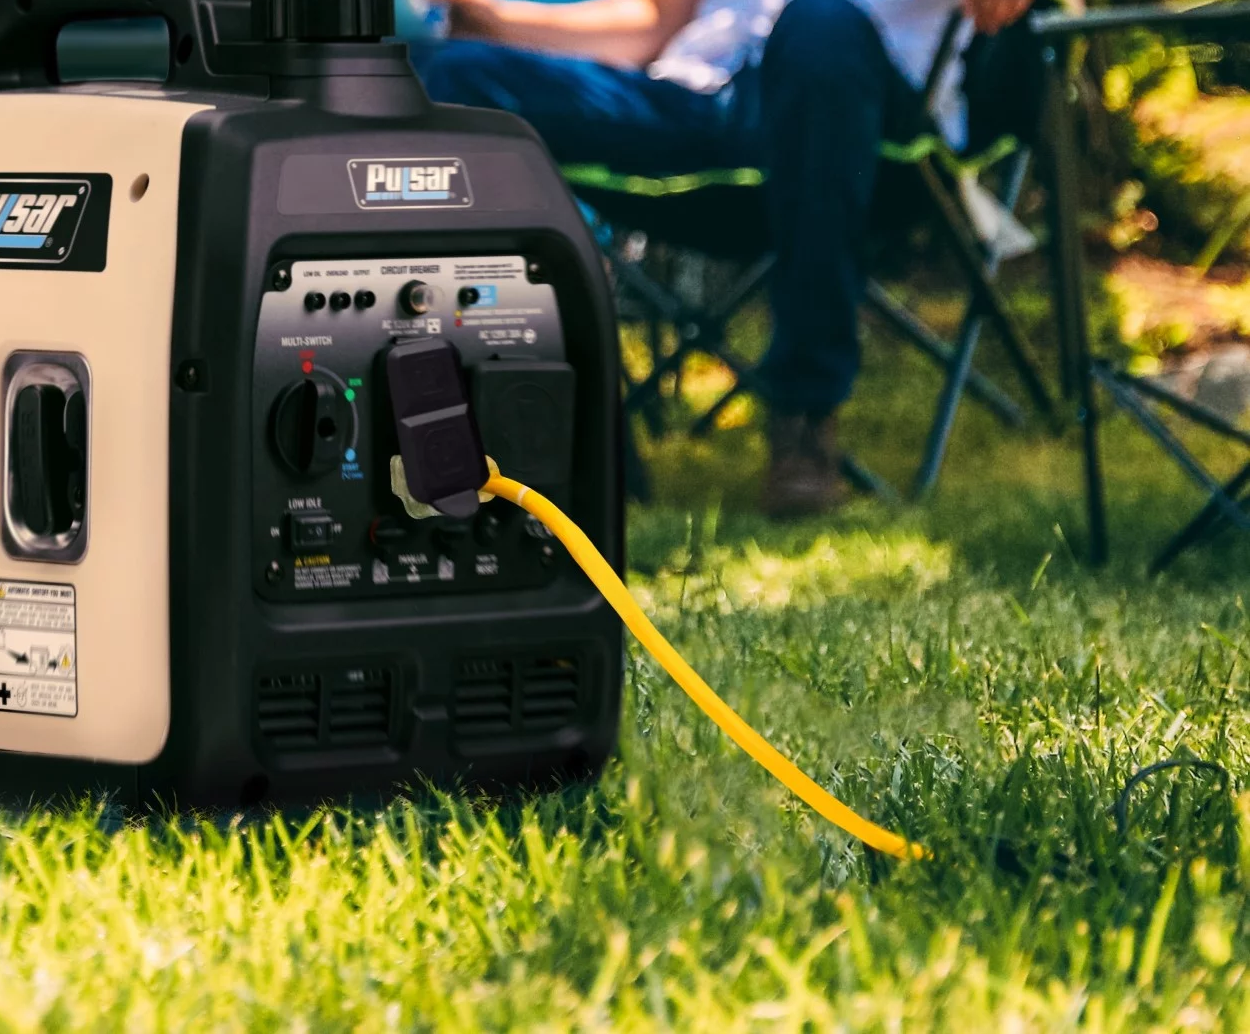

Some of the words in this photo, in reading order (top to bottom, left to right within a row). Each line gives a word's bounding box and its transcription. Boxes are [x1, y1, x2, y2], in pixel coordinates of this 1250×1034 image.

[366, 164, 458, 200] Pulsar
[381, 266, 407, 275] CIRCUIT
[409, 265, 441, 274] BREAKER
[281, 336, 333, 346] MULTI-SWITCH
[288, 498, 304, 509] LOW
[305, 497, 322, 508] IDLE
[270, 526, 280, 538] ON
